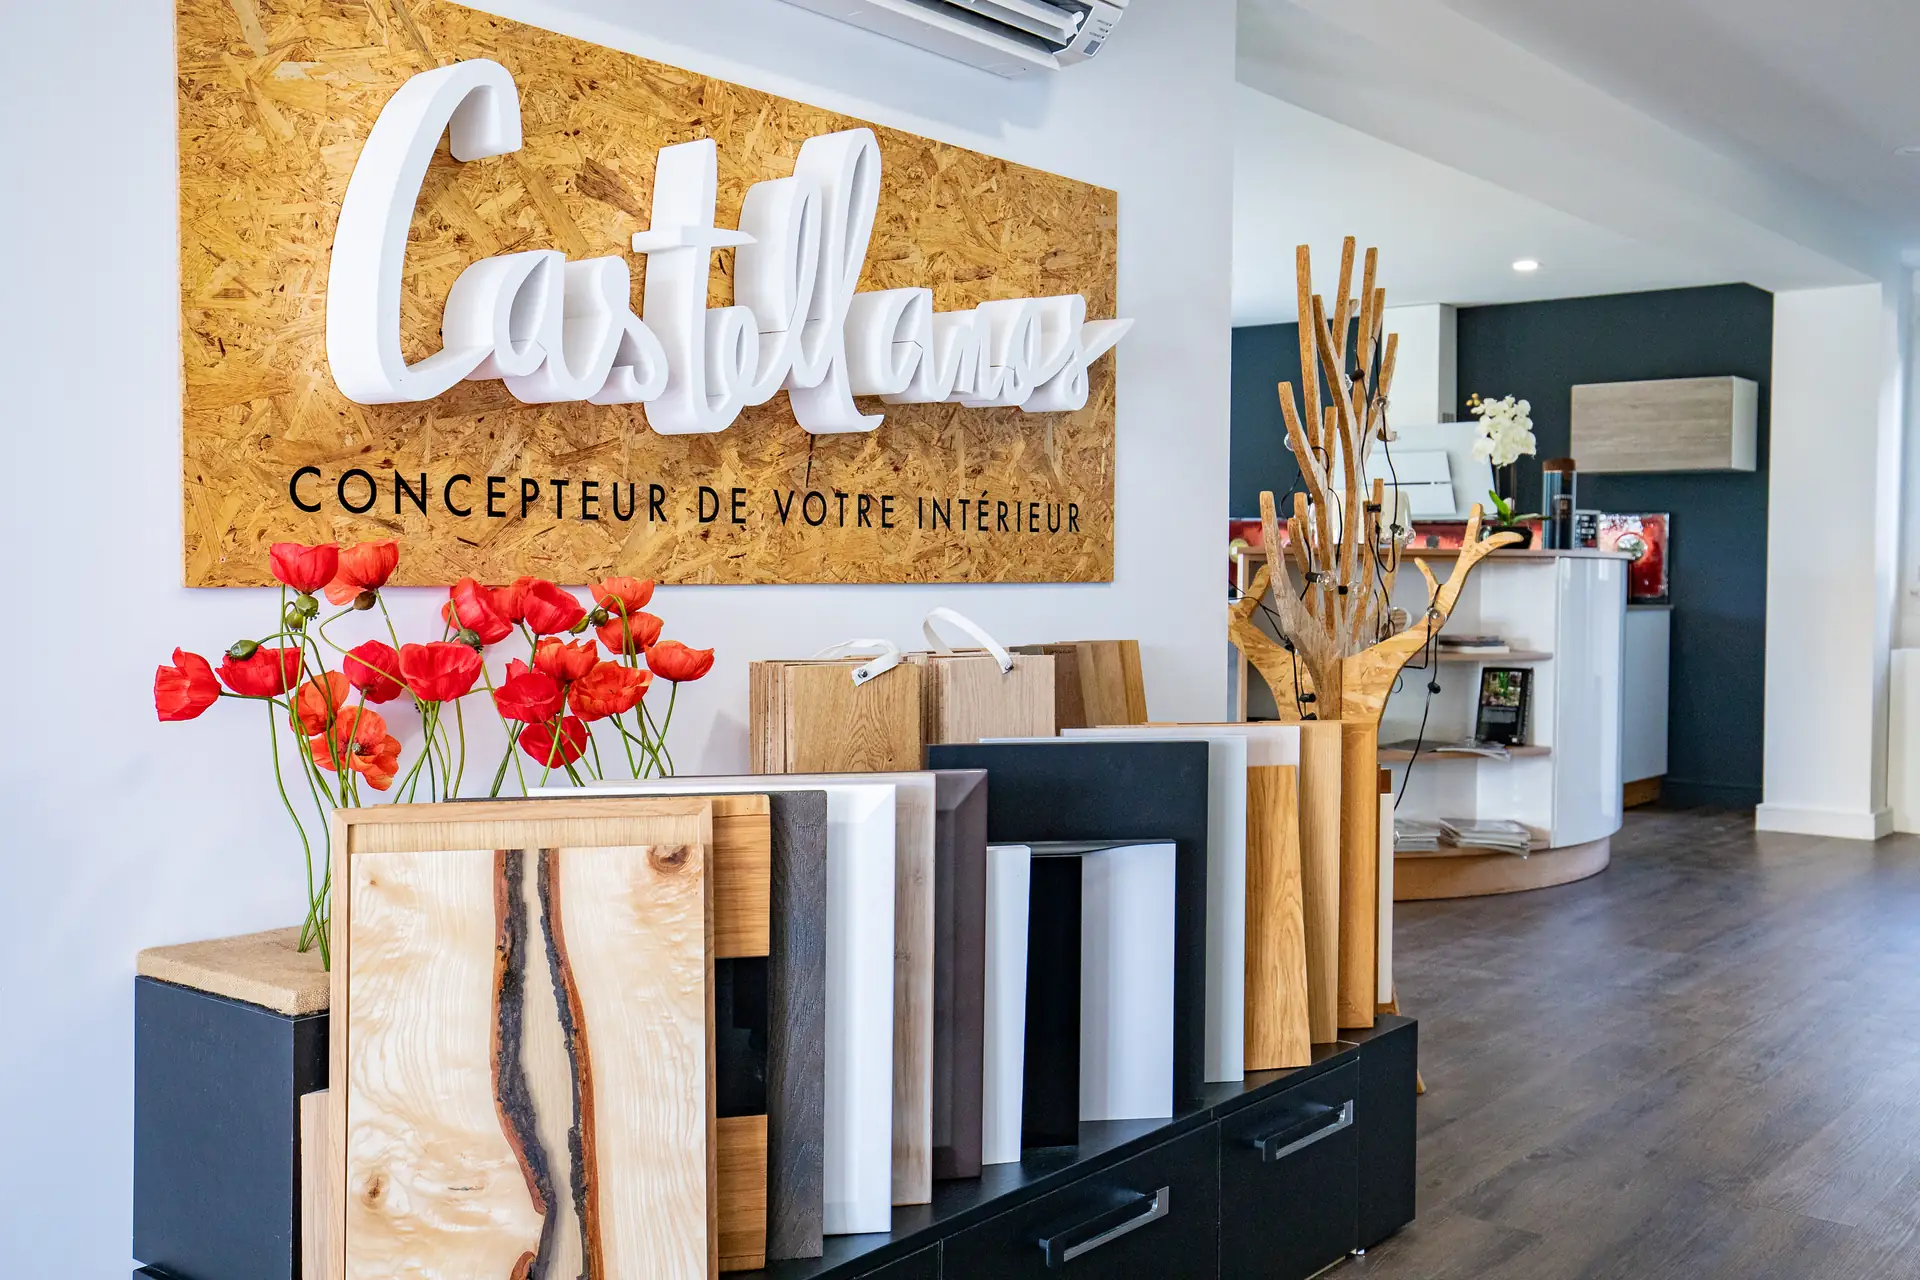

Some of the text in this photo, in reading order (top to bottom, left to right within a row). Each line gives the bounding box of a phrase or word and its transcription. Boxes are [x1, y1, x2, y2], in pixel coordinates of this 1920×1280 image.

[327, 58, 1134, 435] Castellanos
[289, 465, 1080, 534] CONCEPTEUR DE VOTRE INTÉRIEUR
